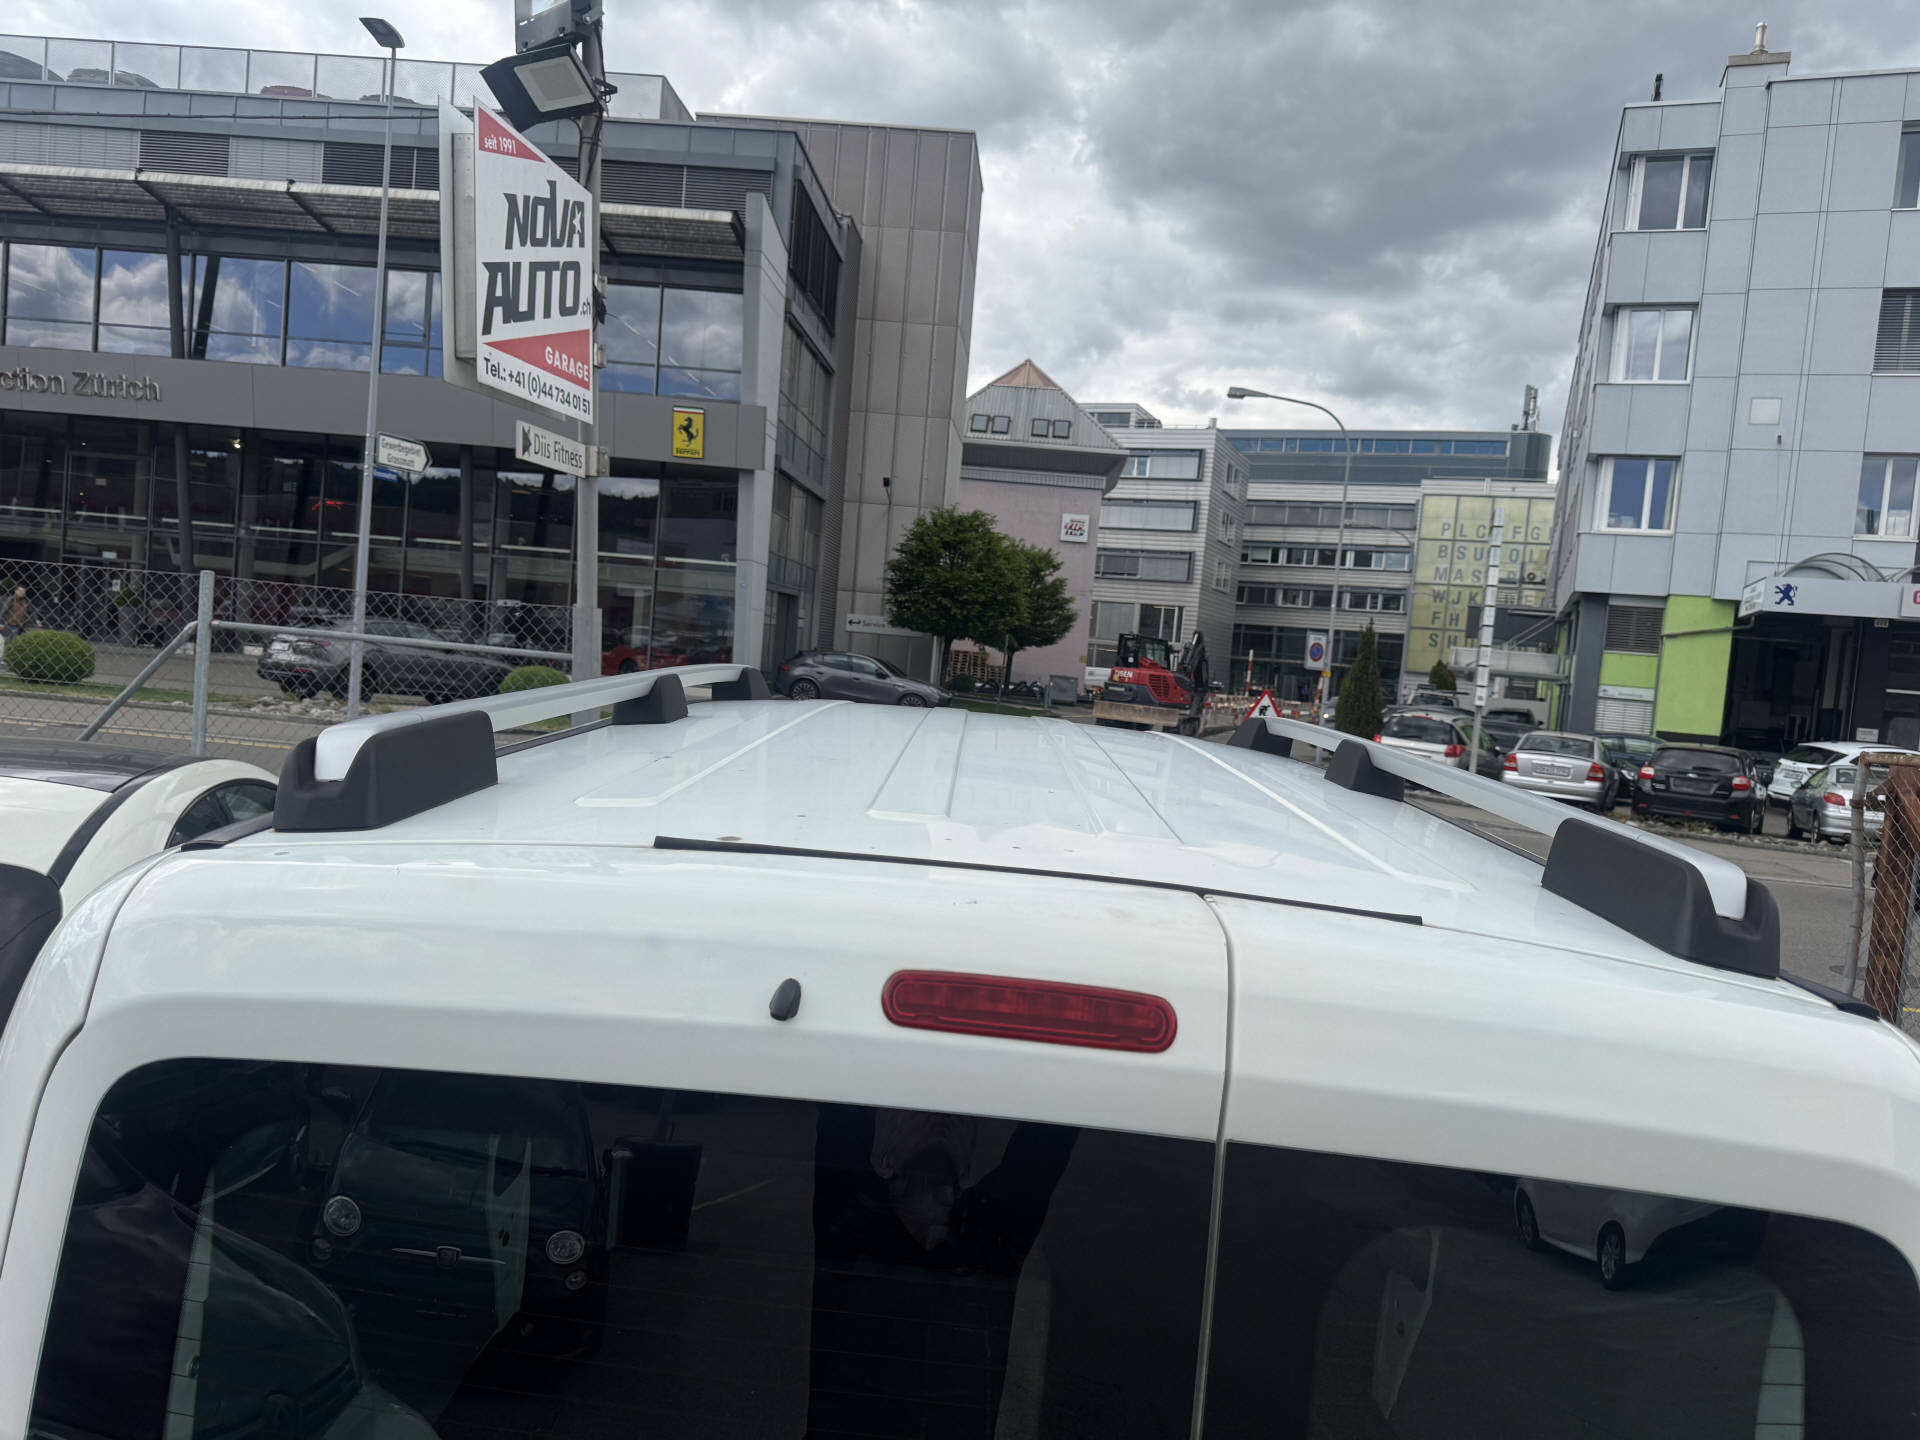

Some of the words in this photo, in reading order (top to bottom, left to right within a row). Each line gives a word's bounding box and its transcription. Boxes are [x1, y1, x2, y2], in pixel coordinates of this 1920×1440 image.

[484, 134, 498, 150] seit
[499, 137, 517, 154] 1991
[503, 180, 586, 250] NOVA
[545, 346, 589, 382] GARAGE
[72, 369, 163, 402] Zürich
[508, 370, 525, 389] +41
[555, 387, 571, 407] 734
[572, 395, 581, 412] 01
[582, 399, 591, 416] 51
[554, 441, 583, 470] Fitness
